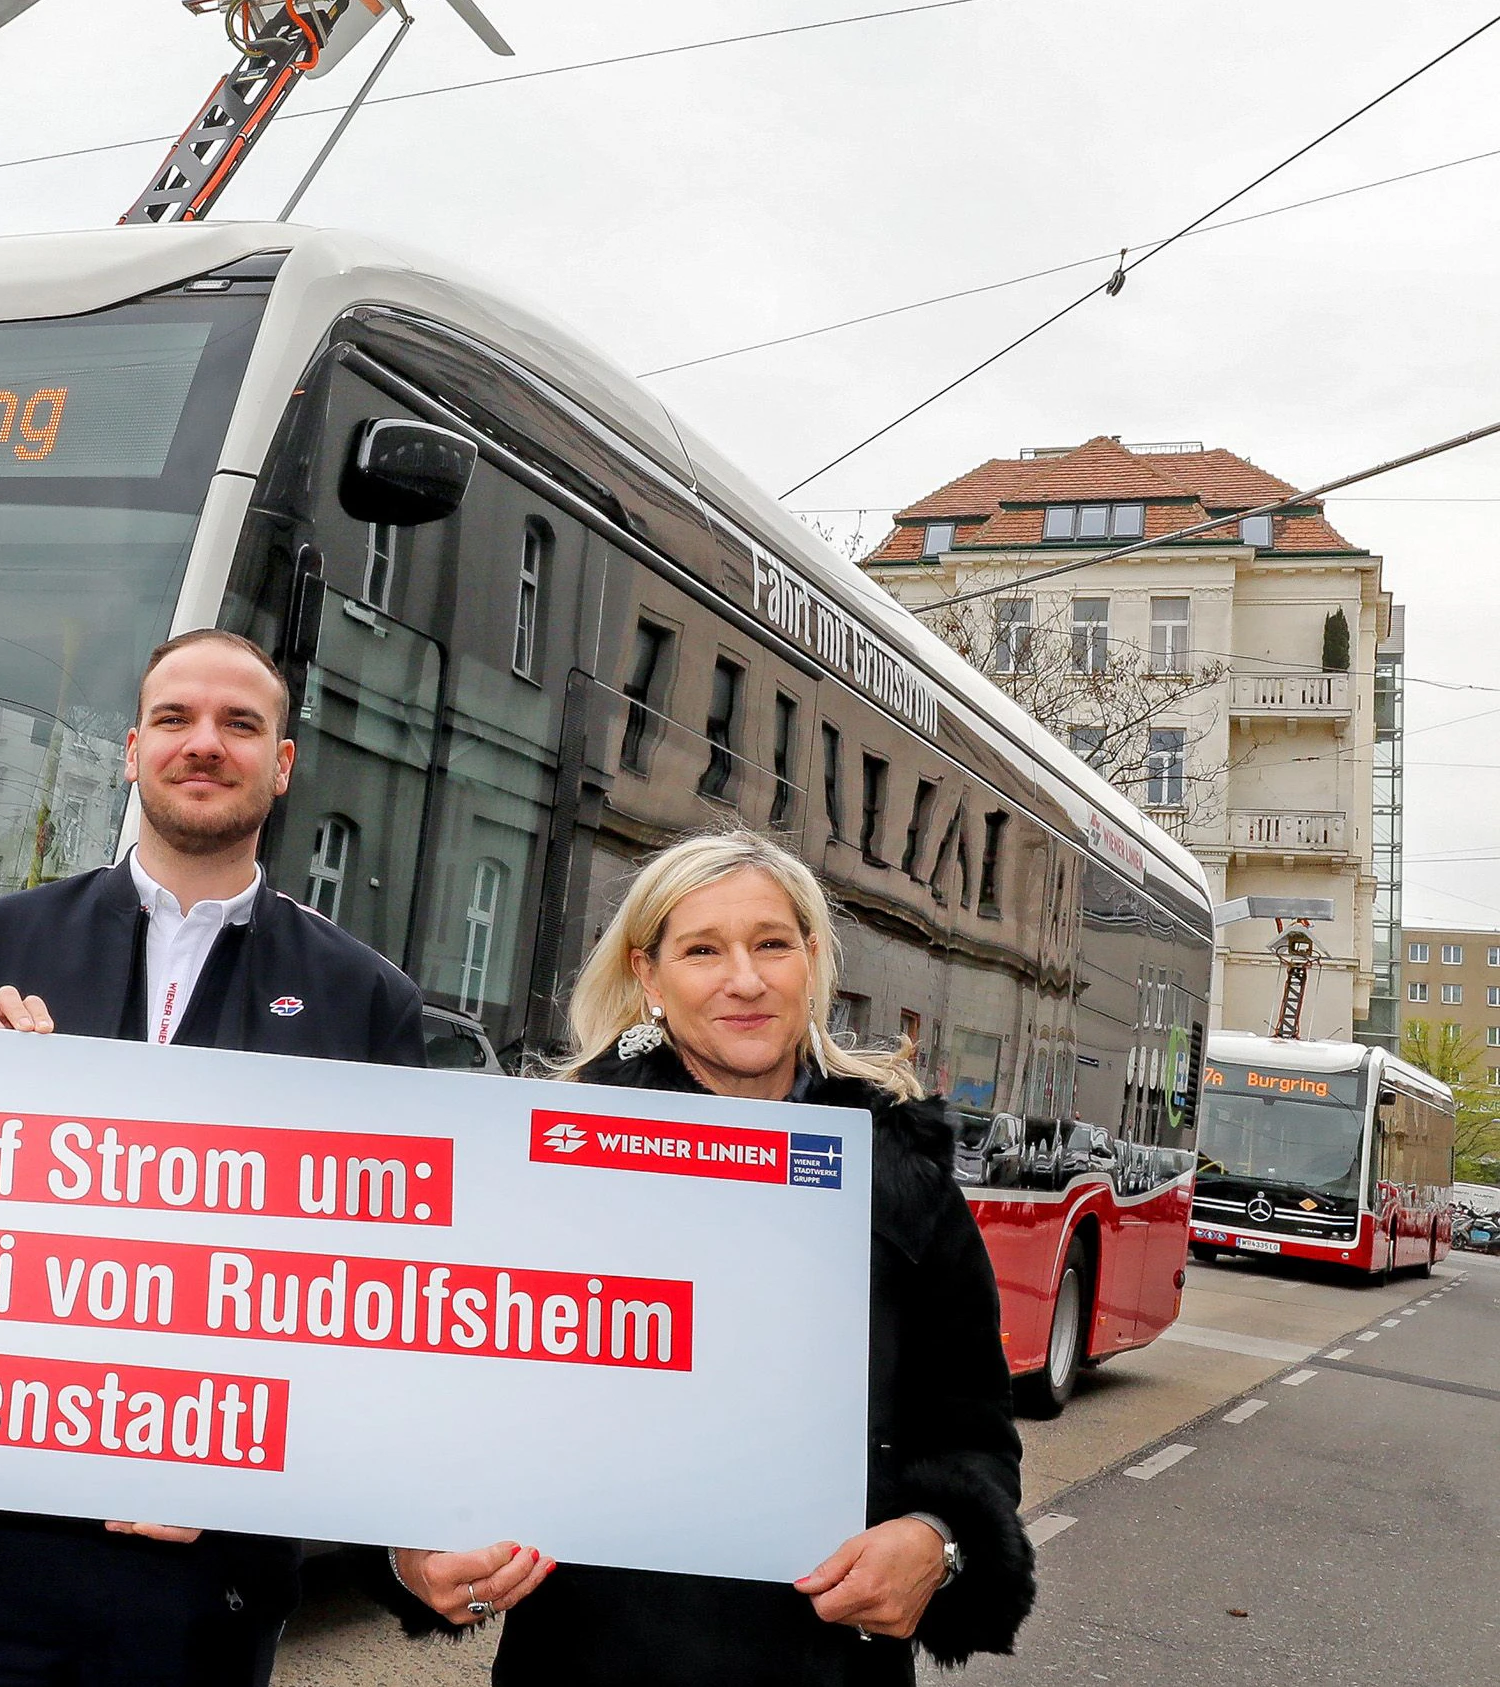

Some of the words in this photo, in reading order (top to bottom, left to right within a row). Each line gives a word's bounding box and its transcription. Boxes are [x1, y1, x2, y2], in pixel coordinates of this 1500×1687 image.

[815, 603, 850, 673] mit
[164, 982, 178, 1017] WIENER
[158, 1018, 171, 1044] LINIE
[1247, 1071, 1328, 1098] Burgring
[597, 1132, 691, 1159] WIENER
[697, 1141, 777, 1168] LINIEN
[793, 1158, 821, 1167] WIENER
[47, 1118, 267, 1211] Strom
[299, 1153, 433, 1221] um:
[793, 1166, 838, 1177] STADTWERKE
[793, 1175, 821, 1184] GRUPPE
[45, 1255, 175, 1326] von
[207, 1250, 673, 1363] Rudolfsheim
